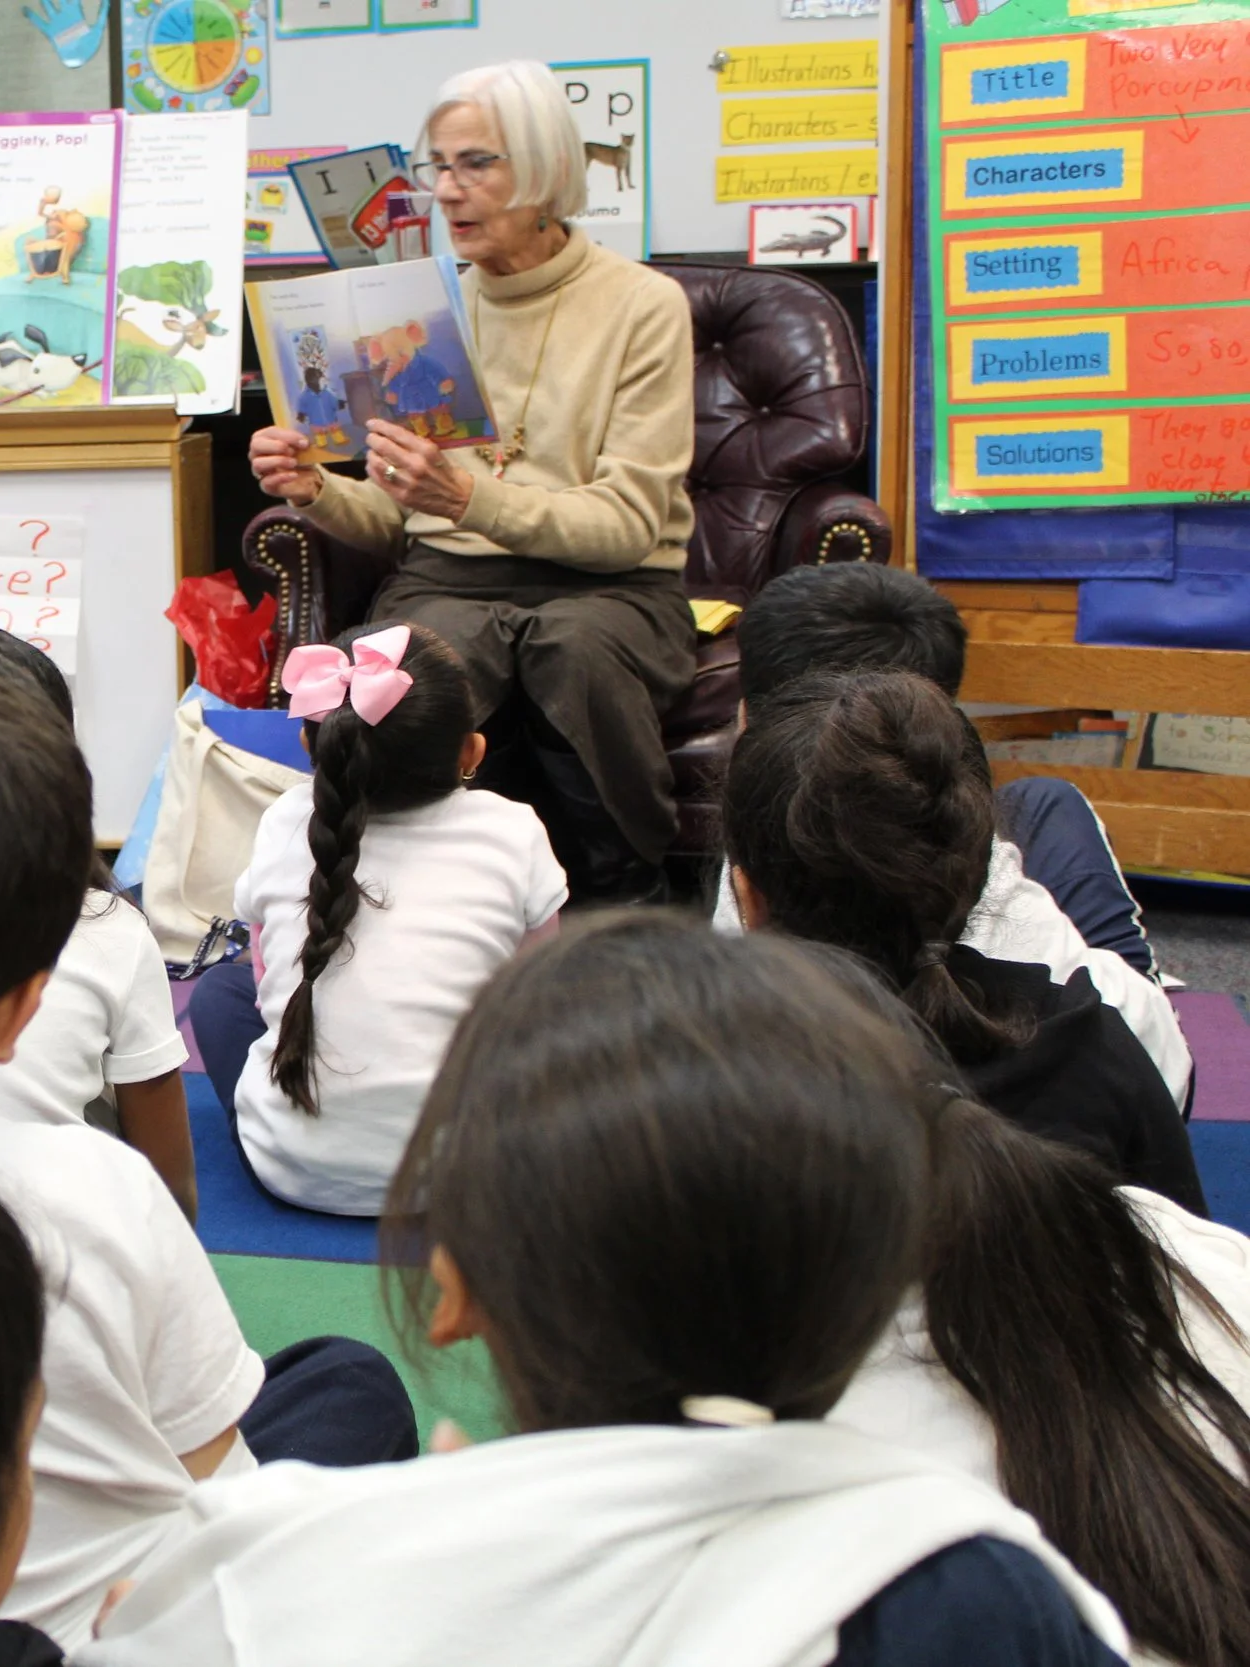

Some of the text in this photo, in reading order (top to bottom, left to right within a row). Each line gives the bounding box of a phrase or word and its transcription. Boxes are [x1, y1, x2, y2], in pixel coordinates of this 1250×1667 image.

[1101, 33, 1228, 68] Two Very
[982, 67, 1055, 92] Title
[608, 92, 633, 126] p
[725, 111, 838, 141] Characters
[55, 133, 88, 148] Pop!
[972, 162, 1105, 187] Characters
[971, 253, 1063, 280] Setting
[1120, 236, 1231, 279] Africa
[979, 349, 1102, 377] Problems
[985, 443, 1095, 466] Solutions
